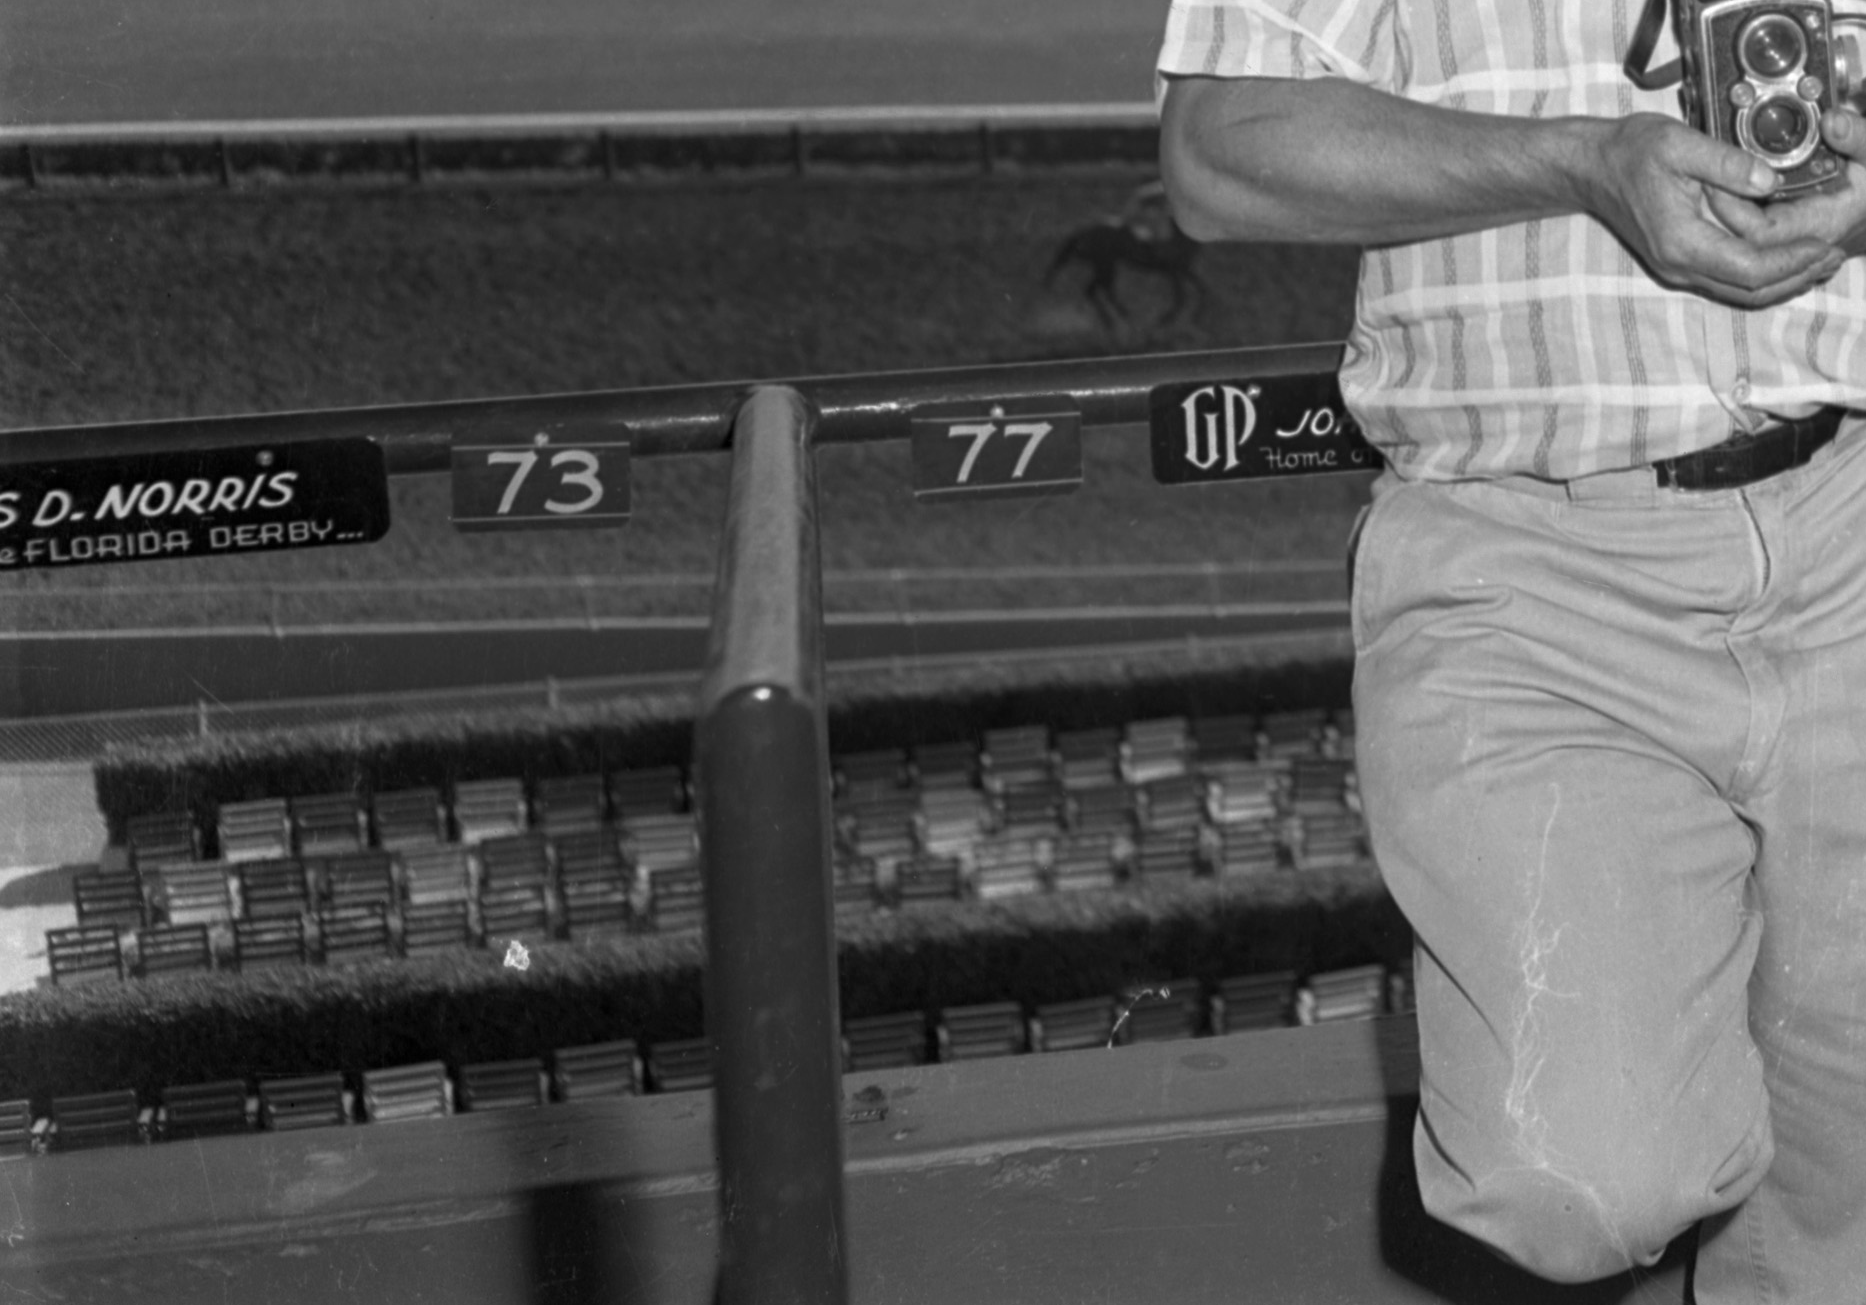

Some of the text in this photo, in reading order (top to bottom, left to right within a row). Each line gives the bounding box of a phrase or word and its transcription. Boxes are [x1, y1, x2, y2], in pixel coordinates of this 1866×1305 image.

[948, 422, 1053, 484] 77
[1180, 384, 1257, 472] GP
[487, 450, 604, 514] 73
[1259, 447, 1338, 469] Home
[32, 489, 85, 527] D.
[94, 471, 299, 520] NORRIS
[23, 529, 191, 563] FLORIDA
